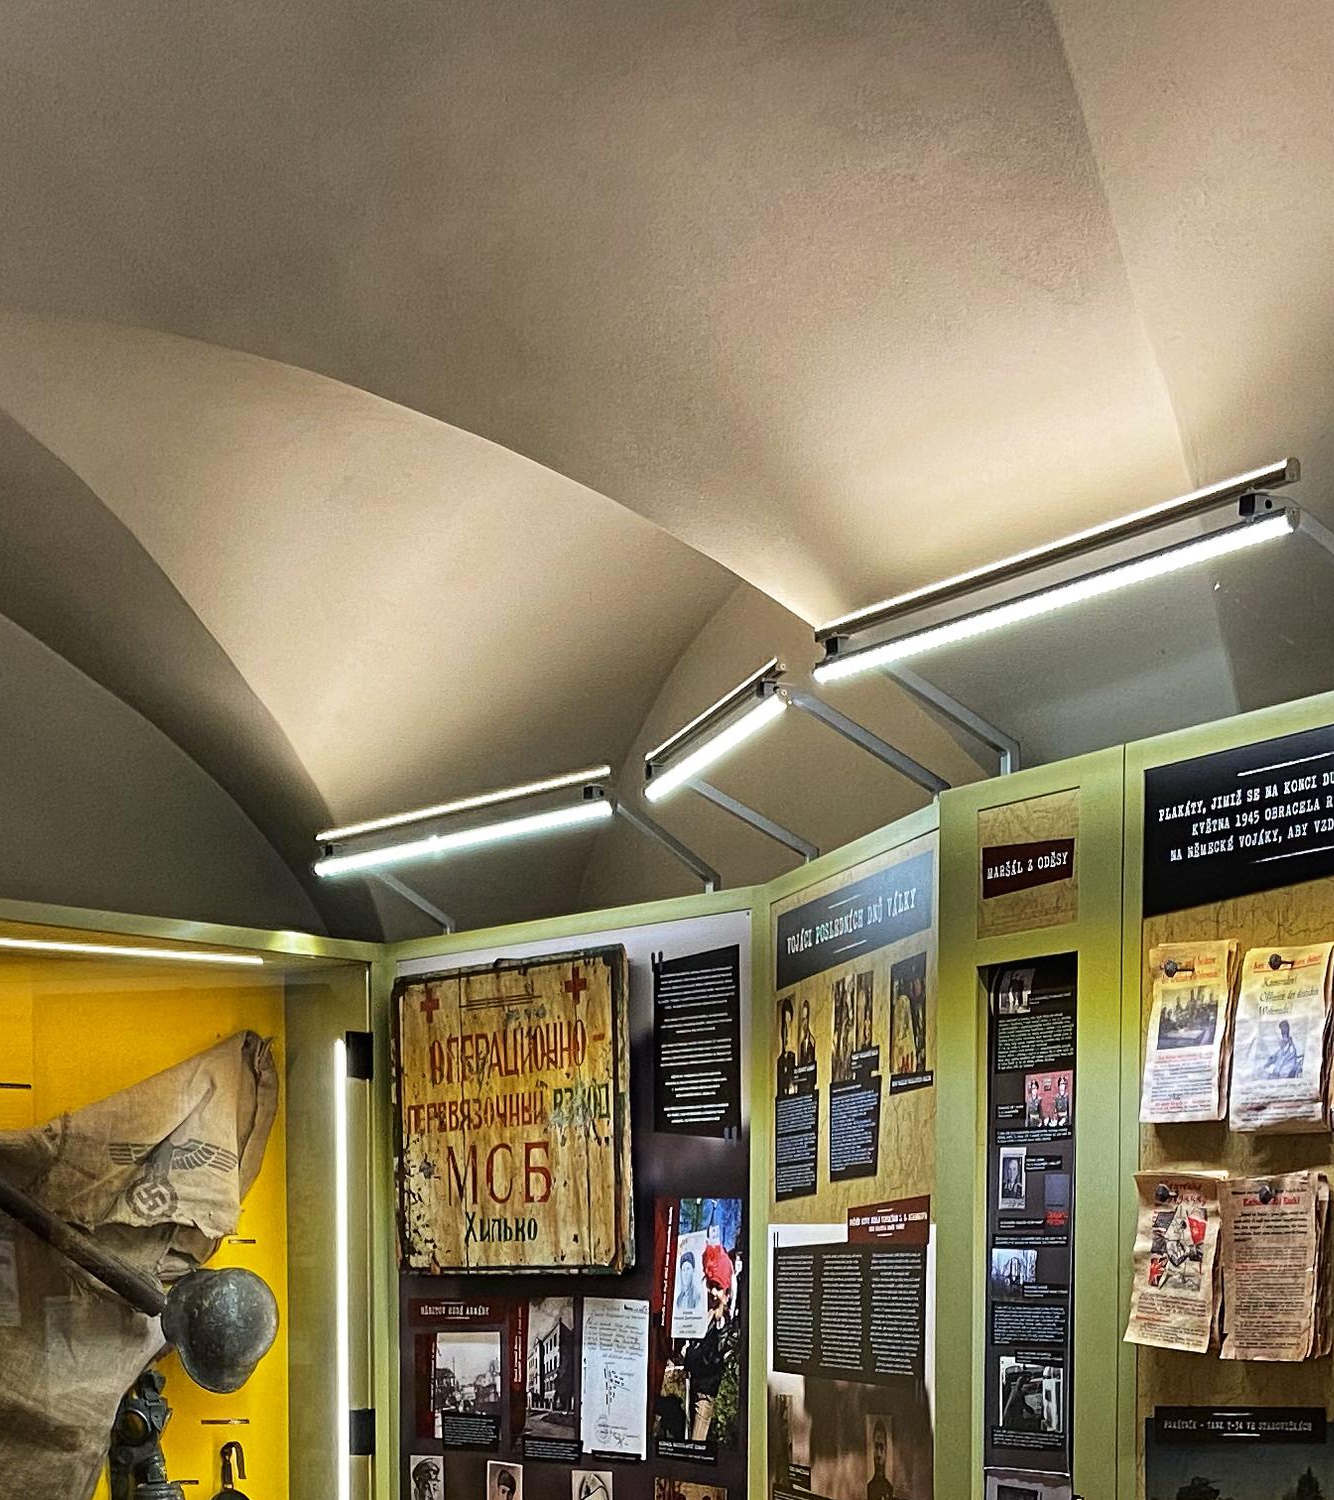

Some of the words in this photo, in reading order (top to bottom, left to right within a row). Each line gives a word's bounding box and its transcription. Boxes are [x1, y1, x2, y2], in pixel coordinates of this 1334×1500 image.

[1159, 801, 1207, 821] PLAKÁTY,
[1211, 789, 1243, 810] JIMIŽ
[1247, 789, 1260, 801] SE
[1265, 786, 1278, 799] NA
[1283, 778, 1317, 795] KONCI
[1192, 816, 1230, 836] KVĚTNA
[1235, 812, 1259, 828] 1945
[1265, 798, 1320, 821] OBRACELA
[1171, 849, 1183, 862] NA
[1187, 838, 1233, 859] NĚMECKÉ
[1239, 829, 1283, 849] VOJÁKY,
[1287, 824, 1307, 840] ABY
[987, 860, 1023, 880] MARŠÁL
[1027, 858, 1033, 872] Z
[1037, 850, 1068, 869] ODĚSY
[787, 928, 813, 954] VOJÁCI
[815, 908, 863, 944] POSLEDNÍCH
[867, 896, 883, 925] DNŮ
[887, 888, 917, 918] VÁLKY
[447, 1141, 553, 1206] МСБ
[465, 1211, 538, 1247] Хилько
